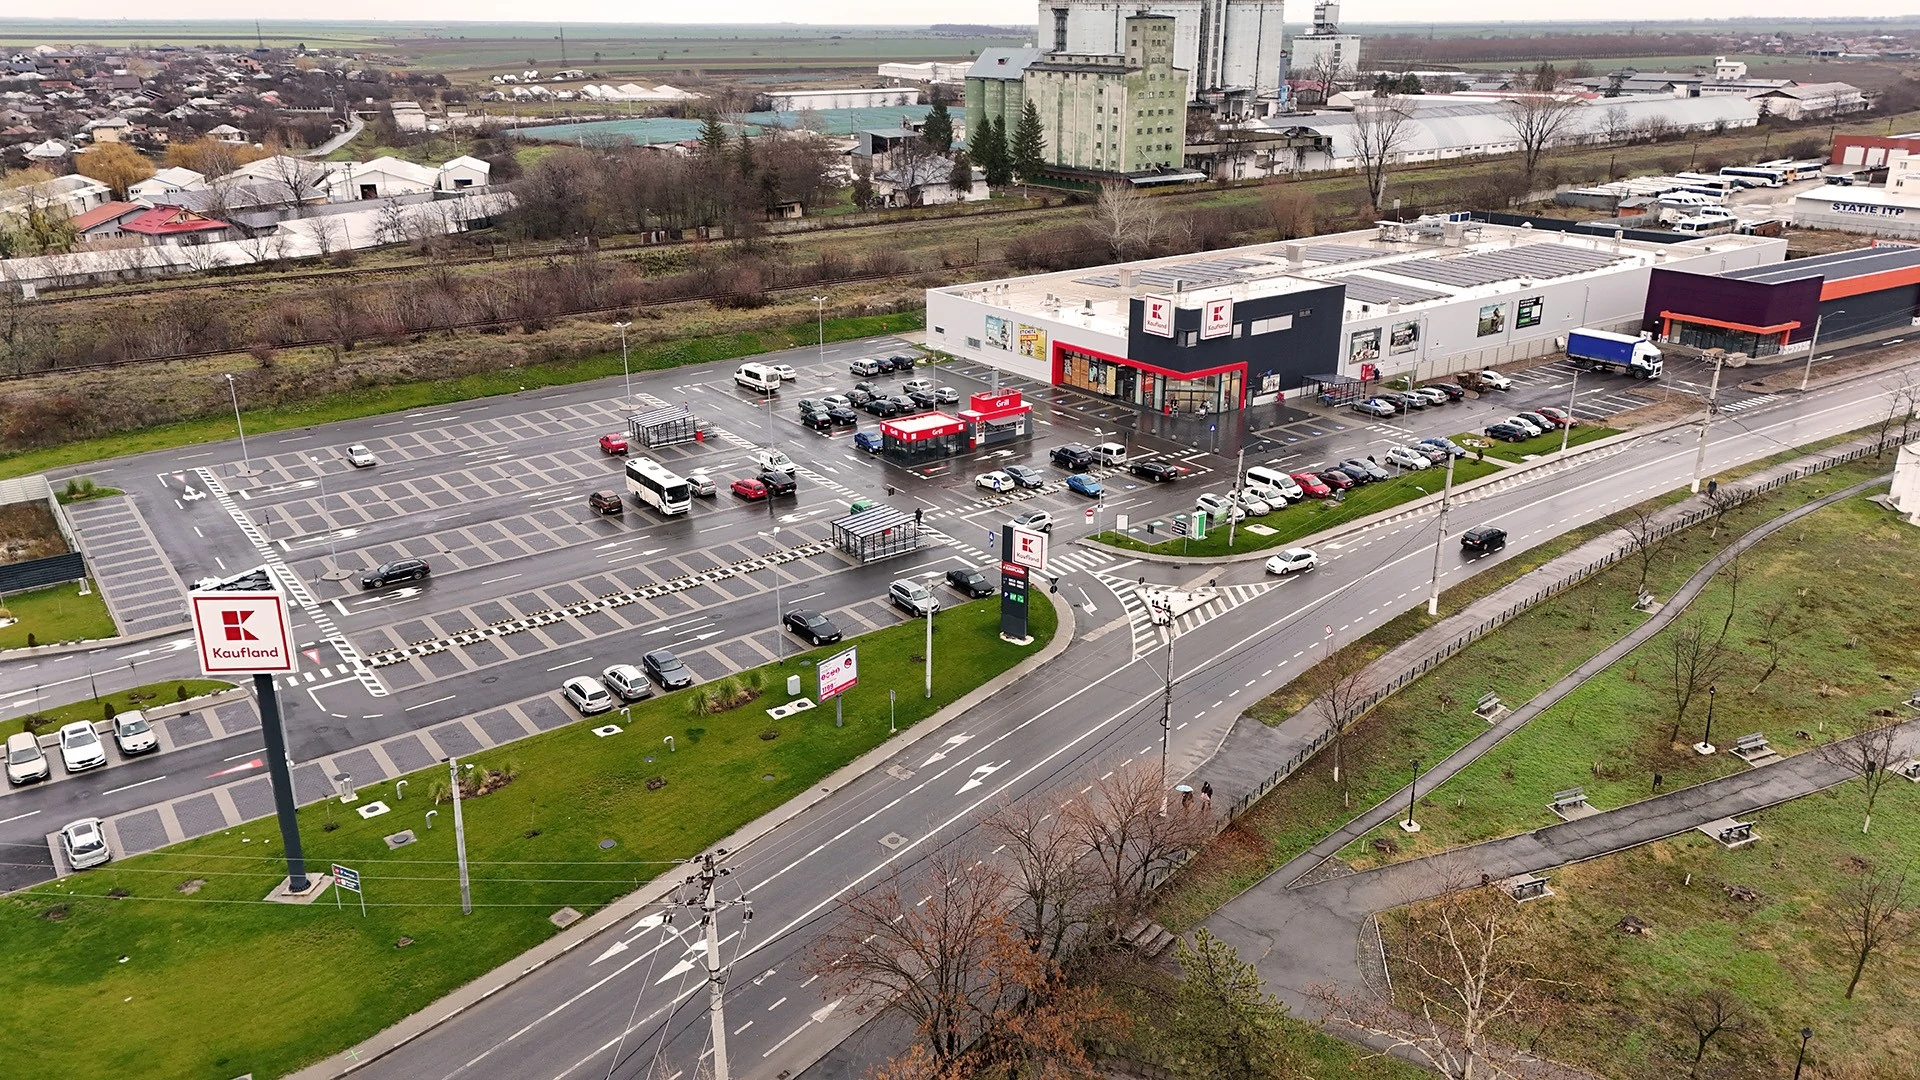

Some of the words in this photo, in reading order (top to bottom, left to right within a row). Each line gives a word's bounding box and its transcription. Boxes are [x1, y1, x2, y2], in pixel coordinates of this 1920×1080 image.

[1832, 202, 1878, 213] STATIE
[1882, 207, 1904, 216] ITP
[1147, 319, 1167, 329] Kaufland
[1208, 321, 1228, 331] Kaufland
[996, 399, 1009, 408] Grill
[890, 428, 898, 436] Grill
[932, 428, 943, 436] Grill
[1016, 551, 1039, 563] Kaufland
[212, 647, 279, 659] Kaufland
